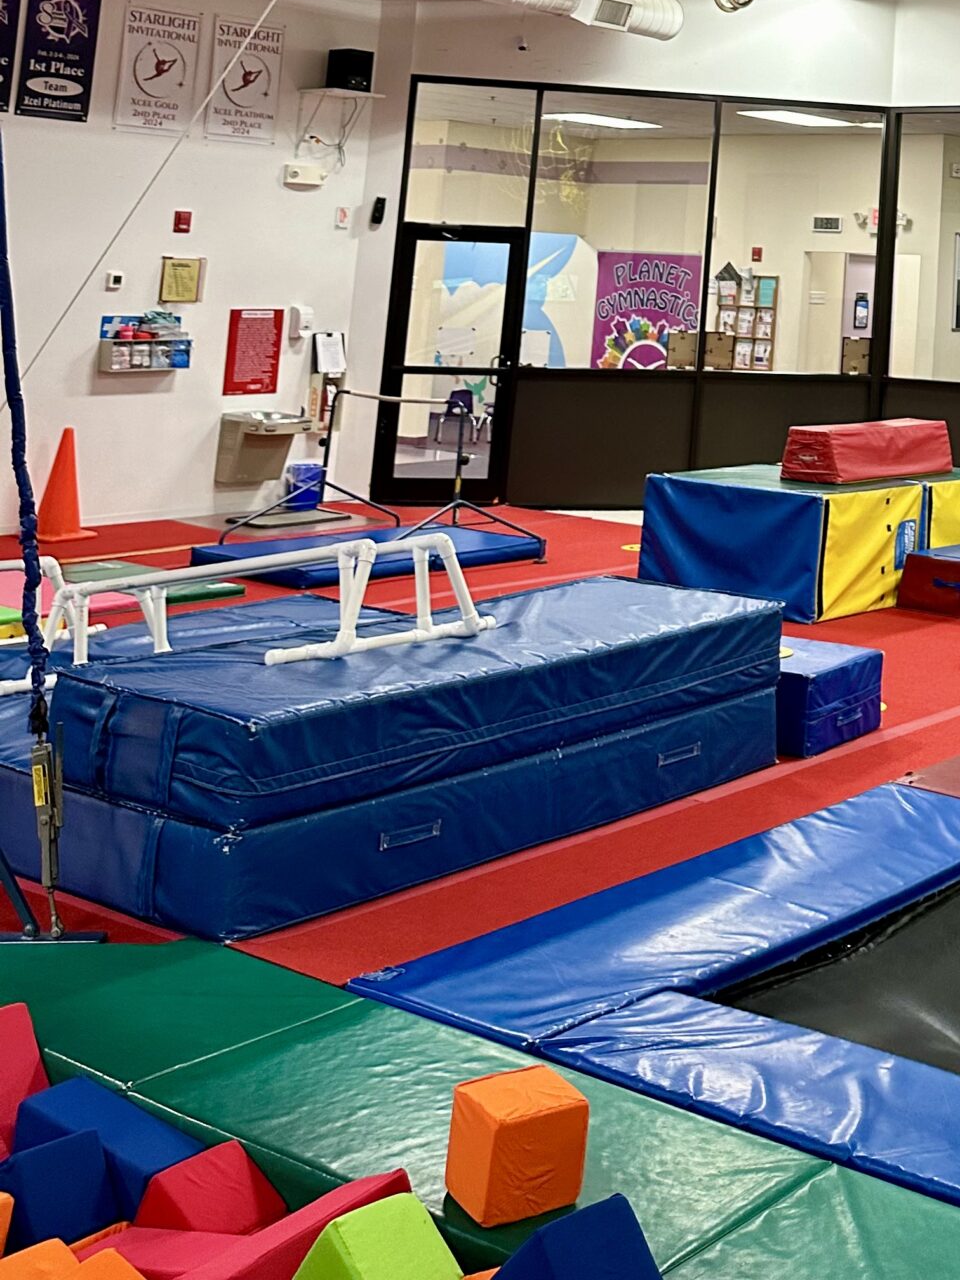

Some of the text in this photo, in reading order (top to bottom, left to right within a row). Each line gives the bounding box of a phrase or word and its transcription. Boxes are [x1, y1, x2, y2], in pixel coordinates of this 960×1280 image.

[129, 10, 198, 31] STARLIGHT
[127, 24, 197, 43] INVITATIONAL
[217, 38, 281, 54] INVITTIONAL
[29, 58, 85, 77] 1st Place
[43, 80, 67, 93] Team
[23, 95, 82, 111] Xcel Platinum
[154, 100, 179, 111] GOLD
[152, 111, 176, 121] PLACE
[234, 109, 274, 121] PLATINUM
[142, 119, 163, 127] 2024
[240, 120, 263, 129] PLACE
[231, 127, 251, 136] 2024
[614, 260, 692, 290] PLANET
